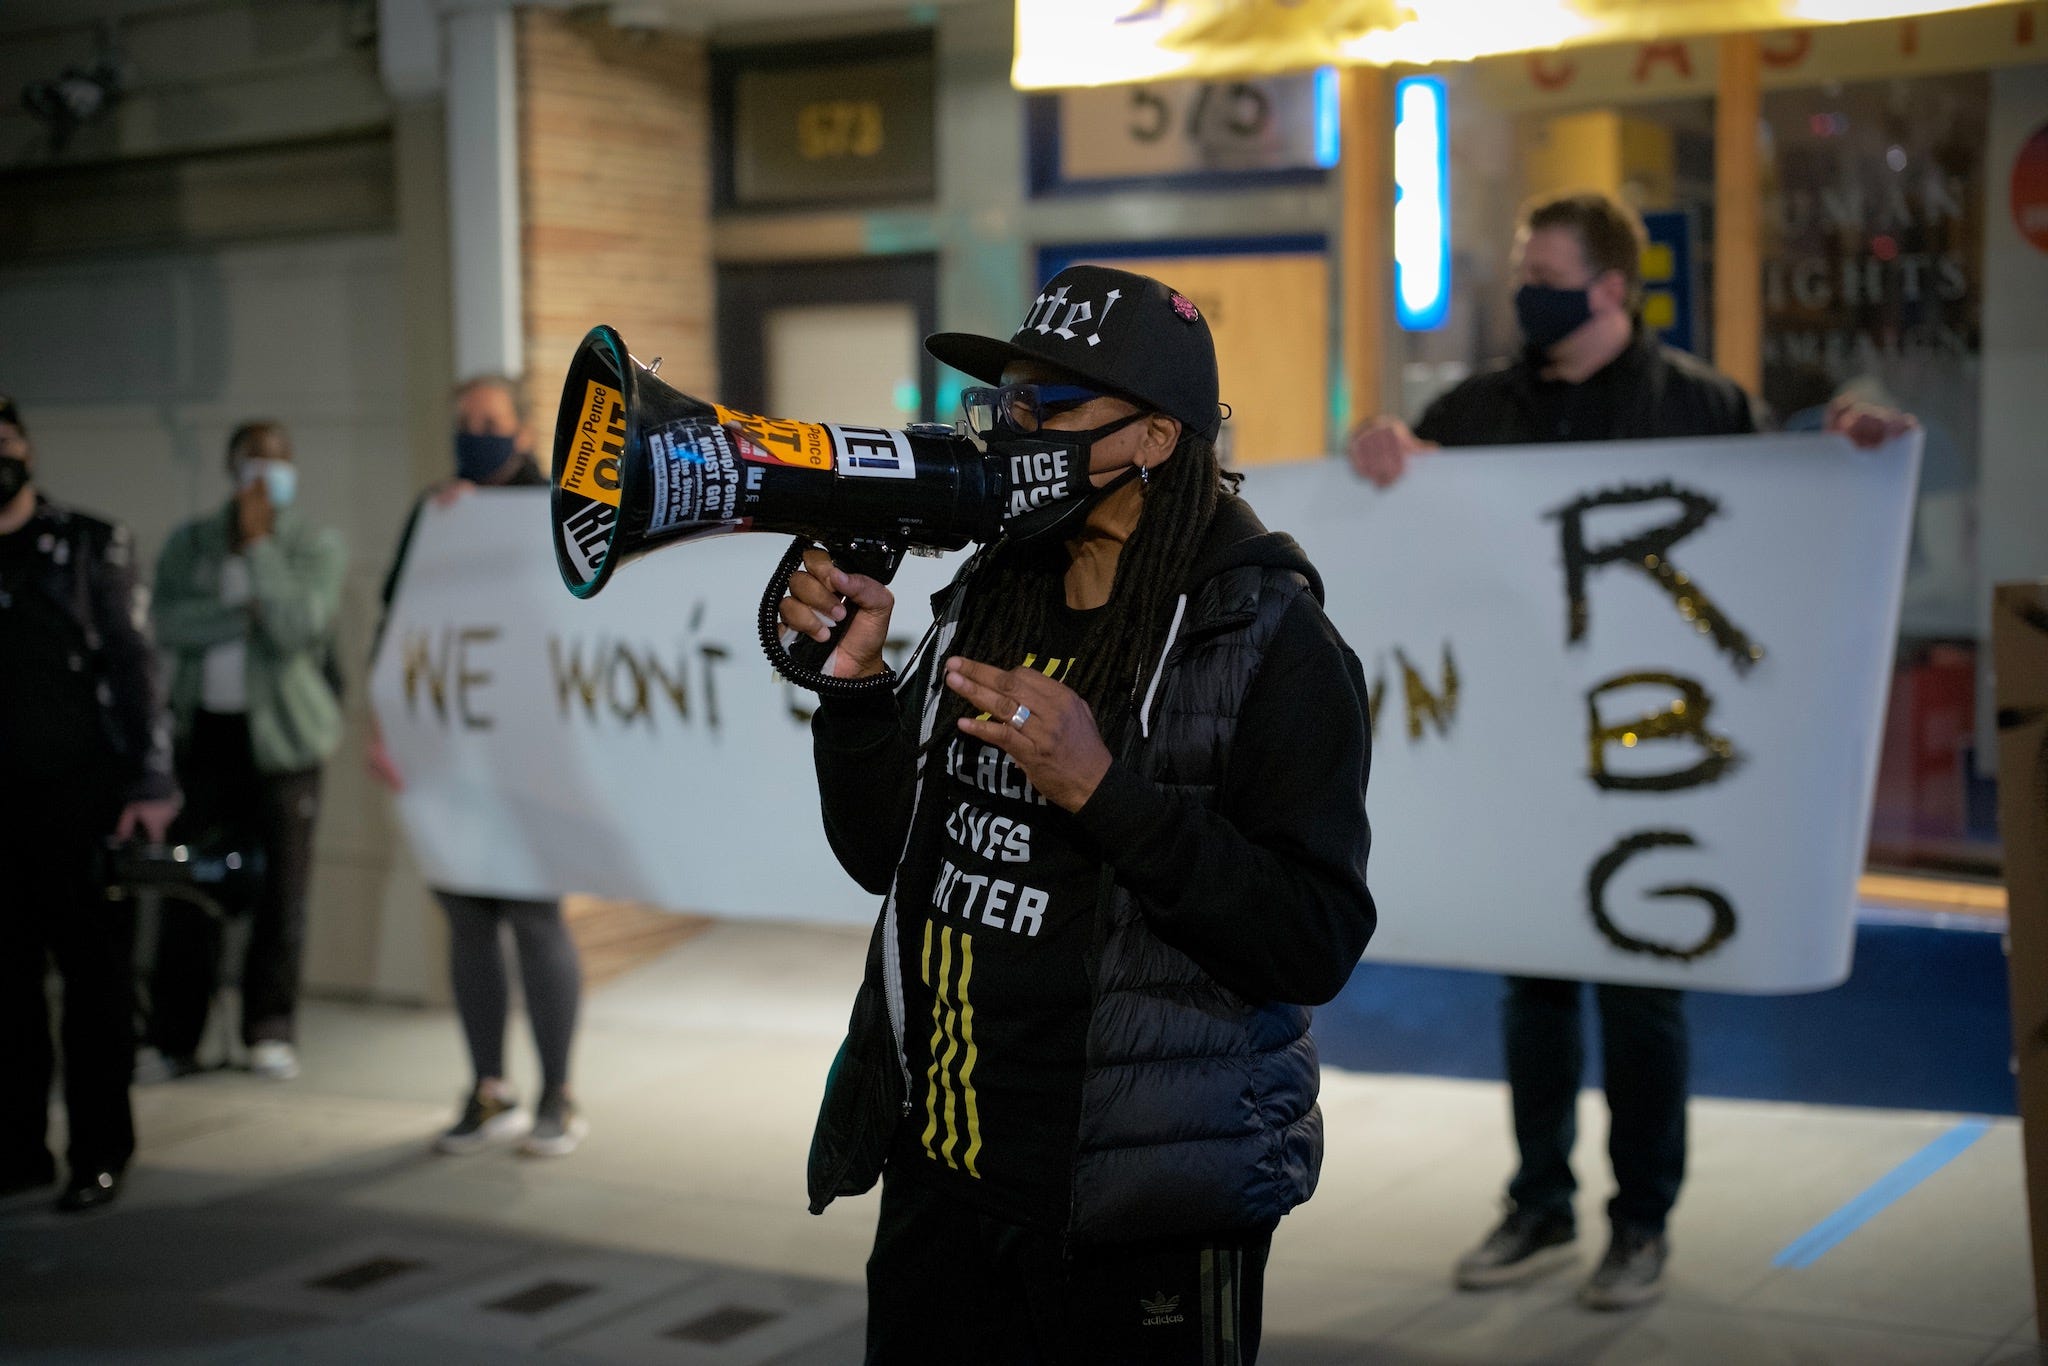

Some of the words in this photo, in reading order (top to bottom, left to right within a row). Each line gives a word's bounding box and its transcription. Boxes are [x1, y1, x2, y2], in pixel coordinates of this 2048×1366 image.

[564, 387, 608, 491] Trump/Pence
[698, 436, 721, 482] MUST
[710, 423, 739, 520] Trump/Pence
[704, 484, 722, 512] GO!
[401, 626, 499, 729] WE
[1141, 1314, 1185, 1326] adidas
